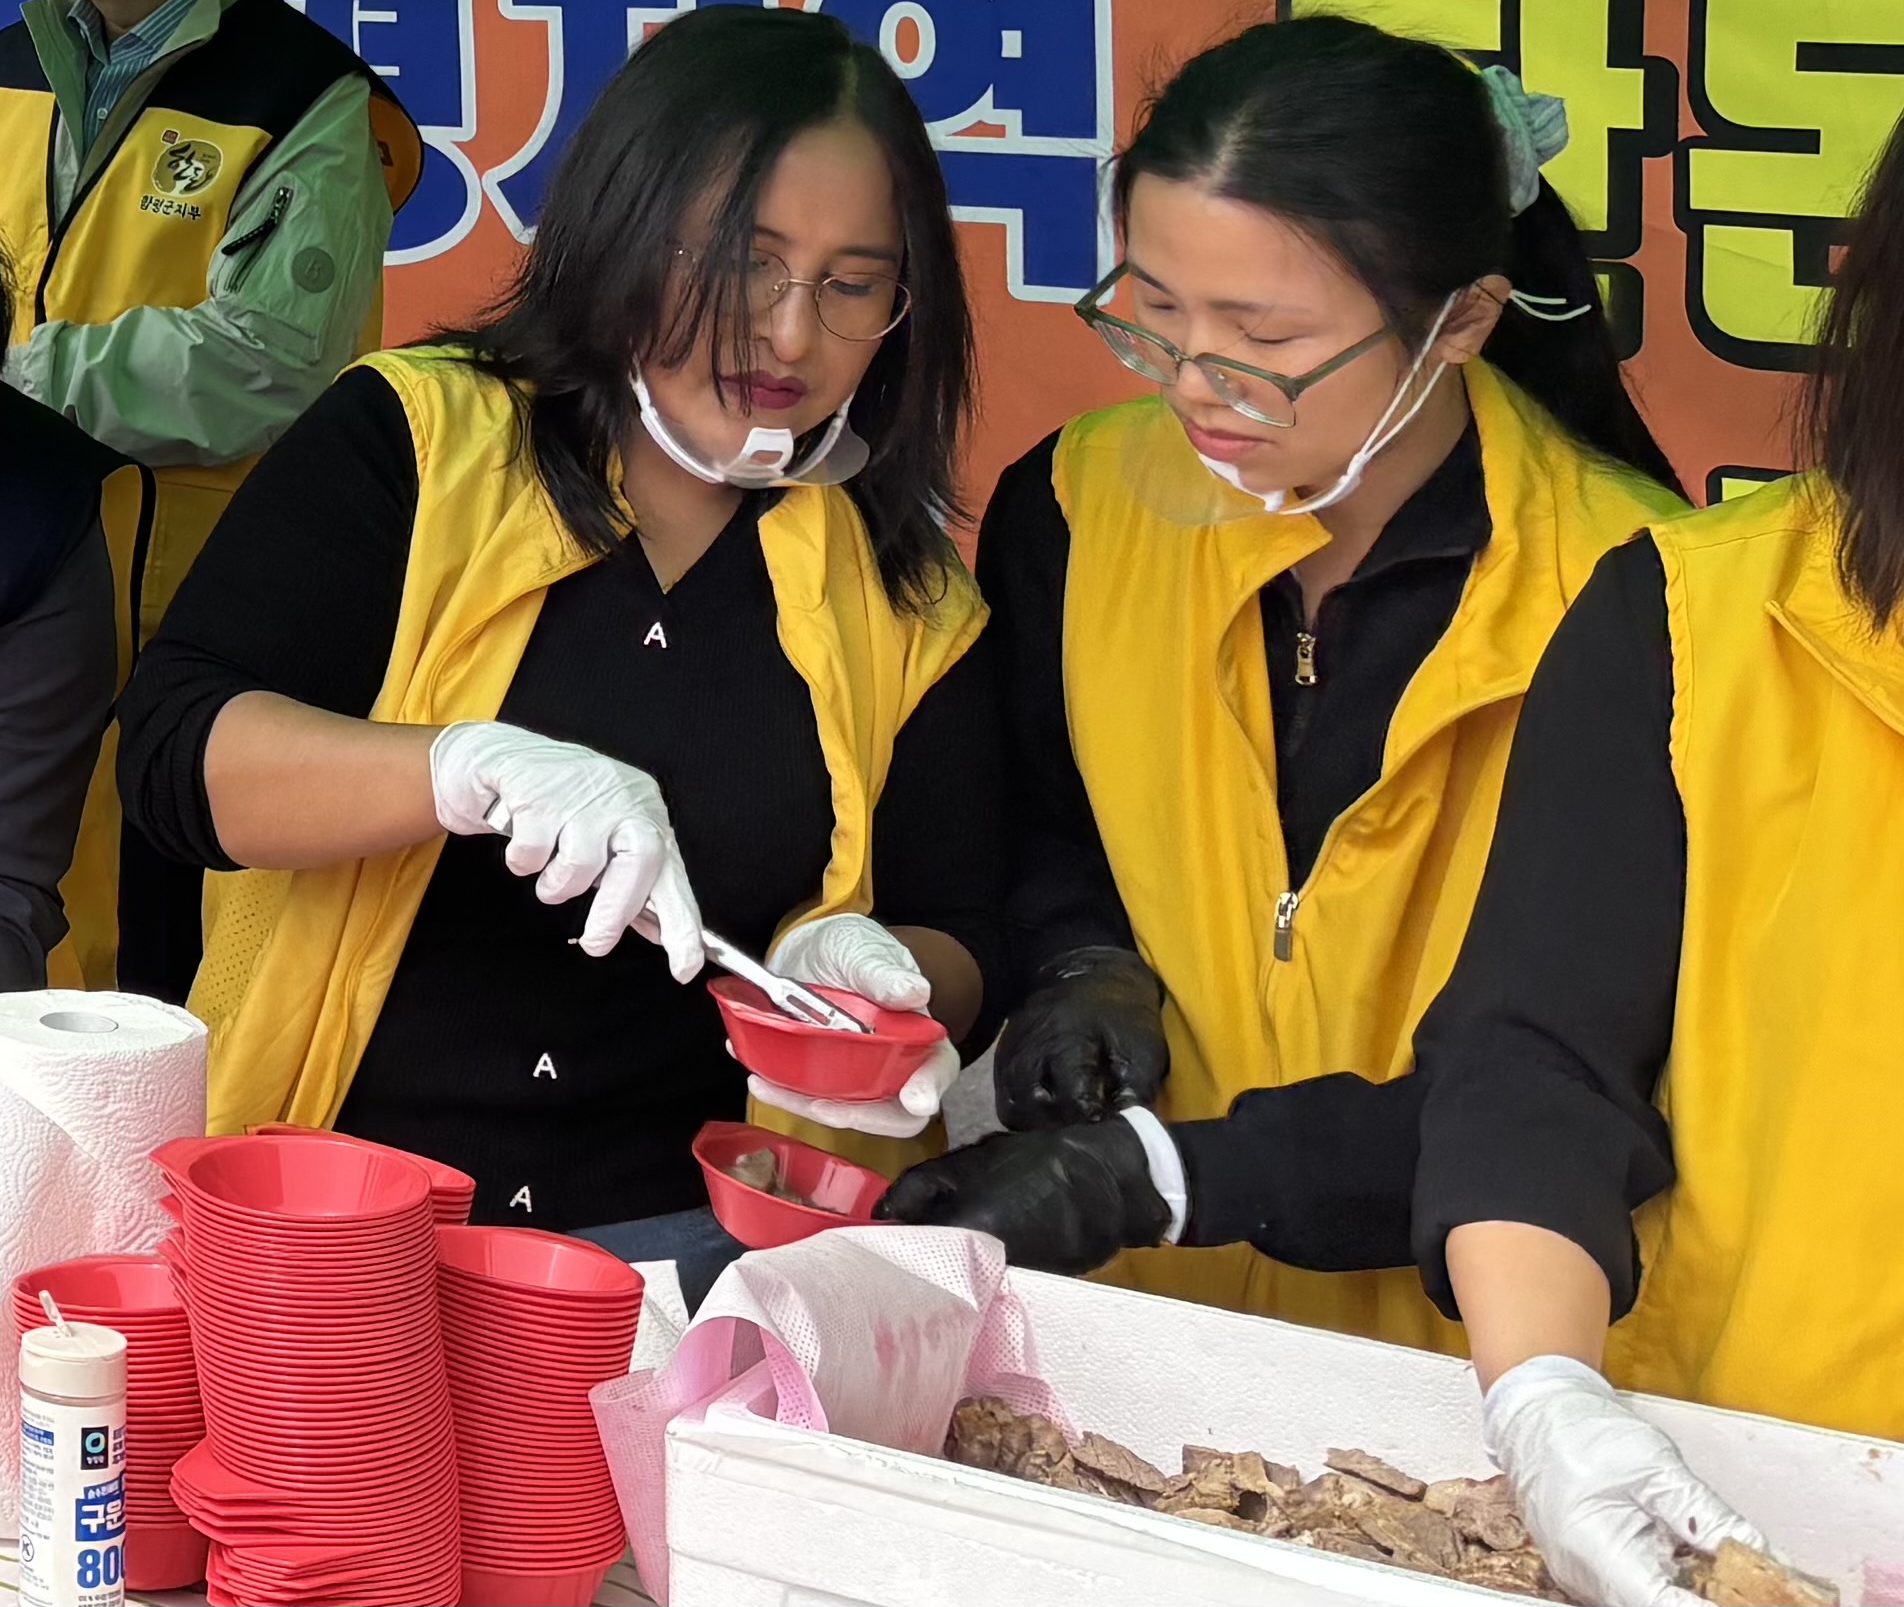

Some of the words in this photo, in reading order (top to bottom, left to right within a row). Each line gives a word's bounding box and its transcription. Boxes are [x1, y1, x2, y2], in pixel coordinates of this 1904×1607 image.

[644, 622, 667, 648] A
[533, 1053, 558, 1079] A
[509, 1185, 533, 1213] A
[80, 1499, 124, 1534] 구운
[77, 1545, 125, 1589] 80
